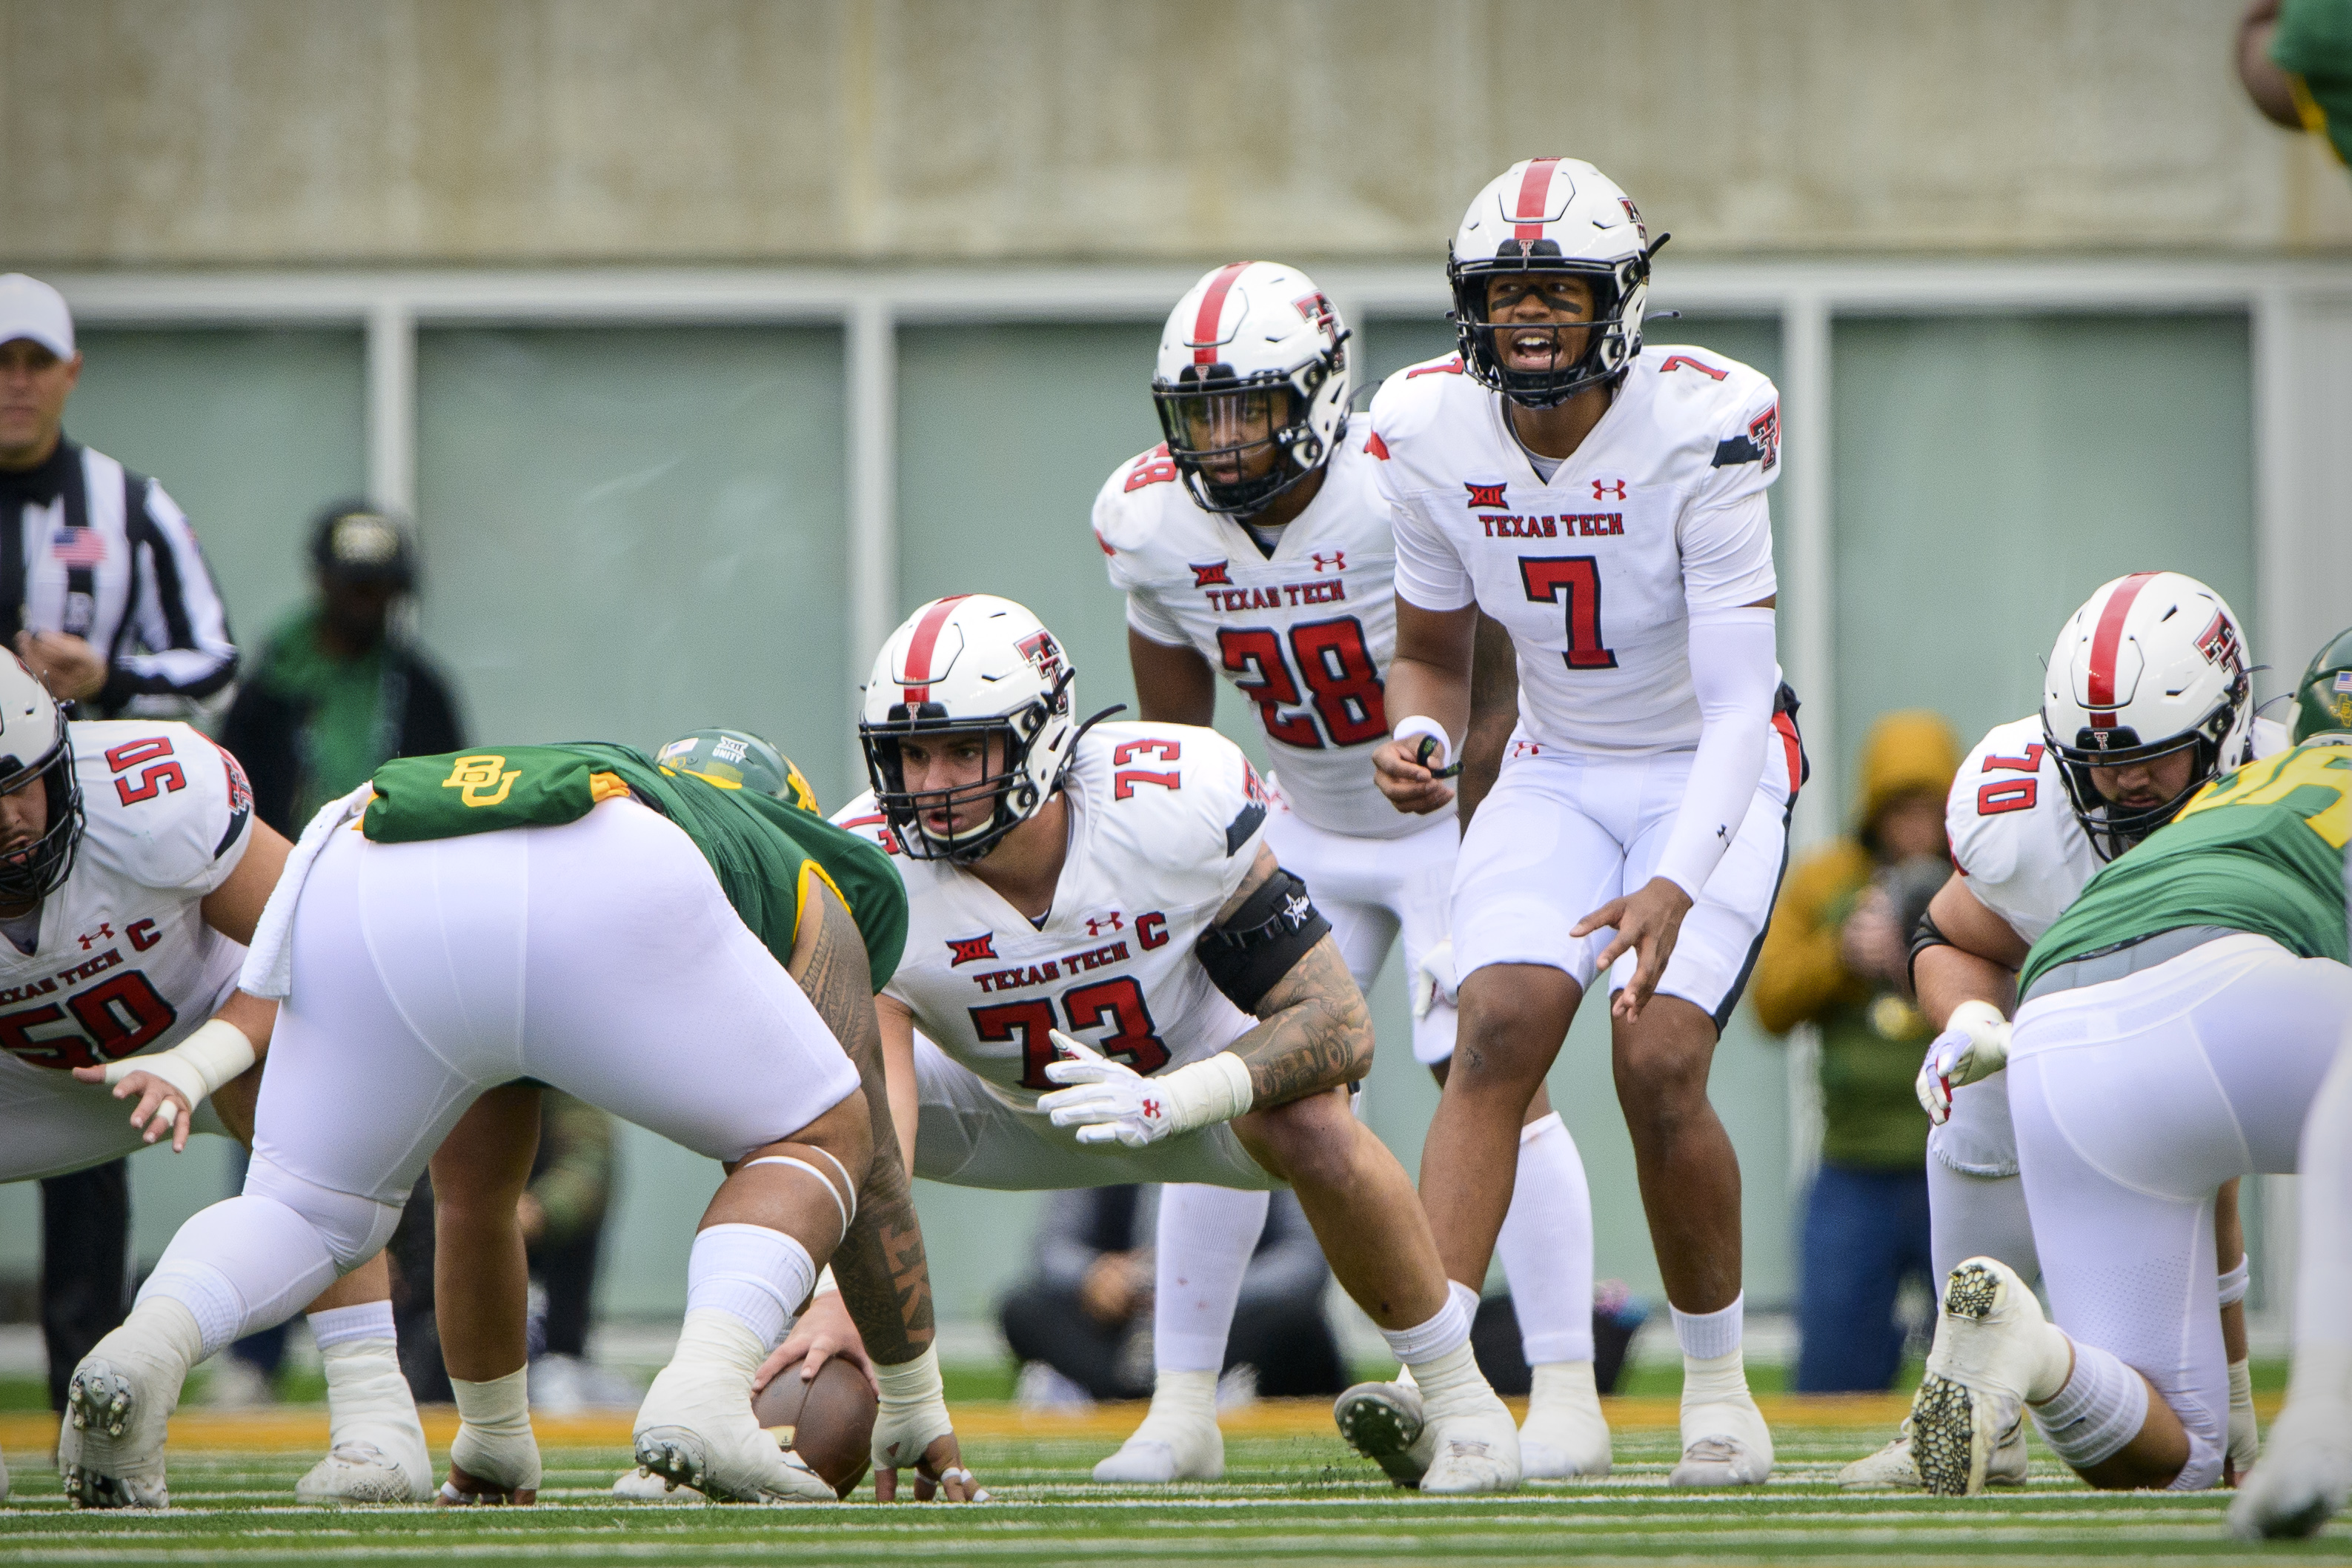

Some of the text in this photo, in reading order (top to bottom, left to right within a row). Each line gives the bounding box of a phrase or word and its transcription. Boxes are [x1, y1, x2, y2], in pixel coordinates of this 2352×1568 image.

[1658, 355, 1730, 382] 7
[1478, 513, 1624, 537] TEXAS TECH
[1206, 578, 1346, 611] TEXAS TECH
[1518, 555, 1619, 670] 7
[1216, 614, 1389, 749] 28
[104, 736, 187, 807] 50
[442, 755, 522, 807] BU
[712, 747, 745, 763] UNITY
[1113, 737, 1181, 801] 73
[1977, 743, 2045, 816] 70
[125, 917, 163, 952] C
[1135, 911, 1170, 951] C
[0, 947, 124, 1006] EXAS TECH
[973, 941, 1131, 993] TEXAS TECH
[0, 969, 178, 1069] 50
[968, 974, 1172, 1090] 73
